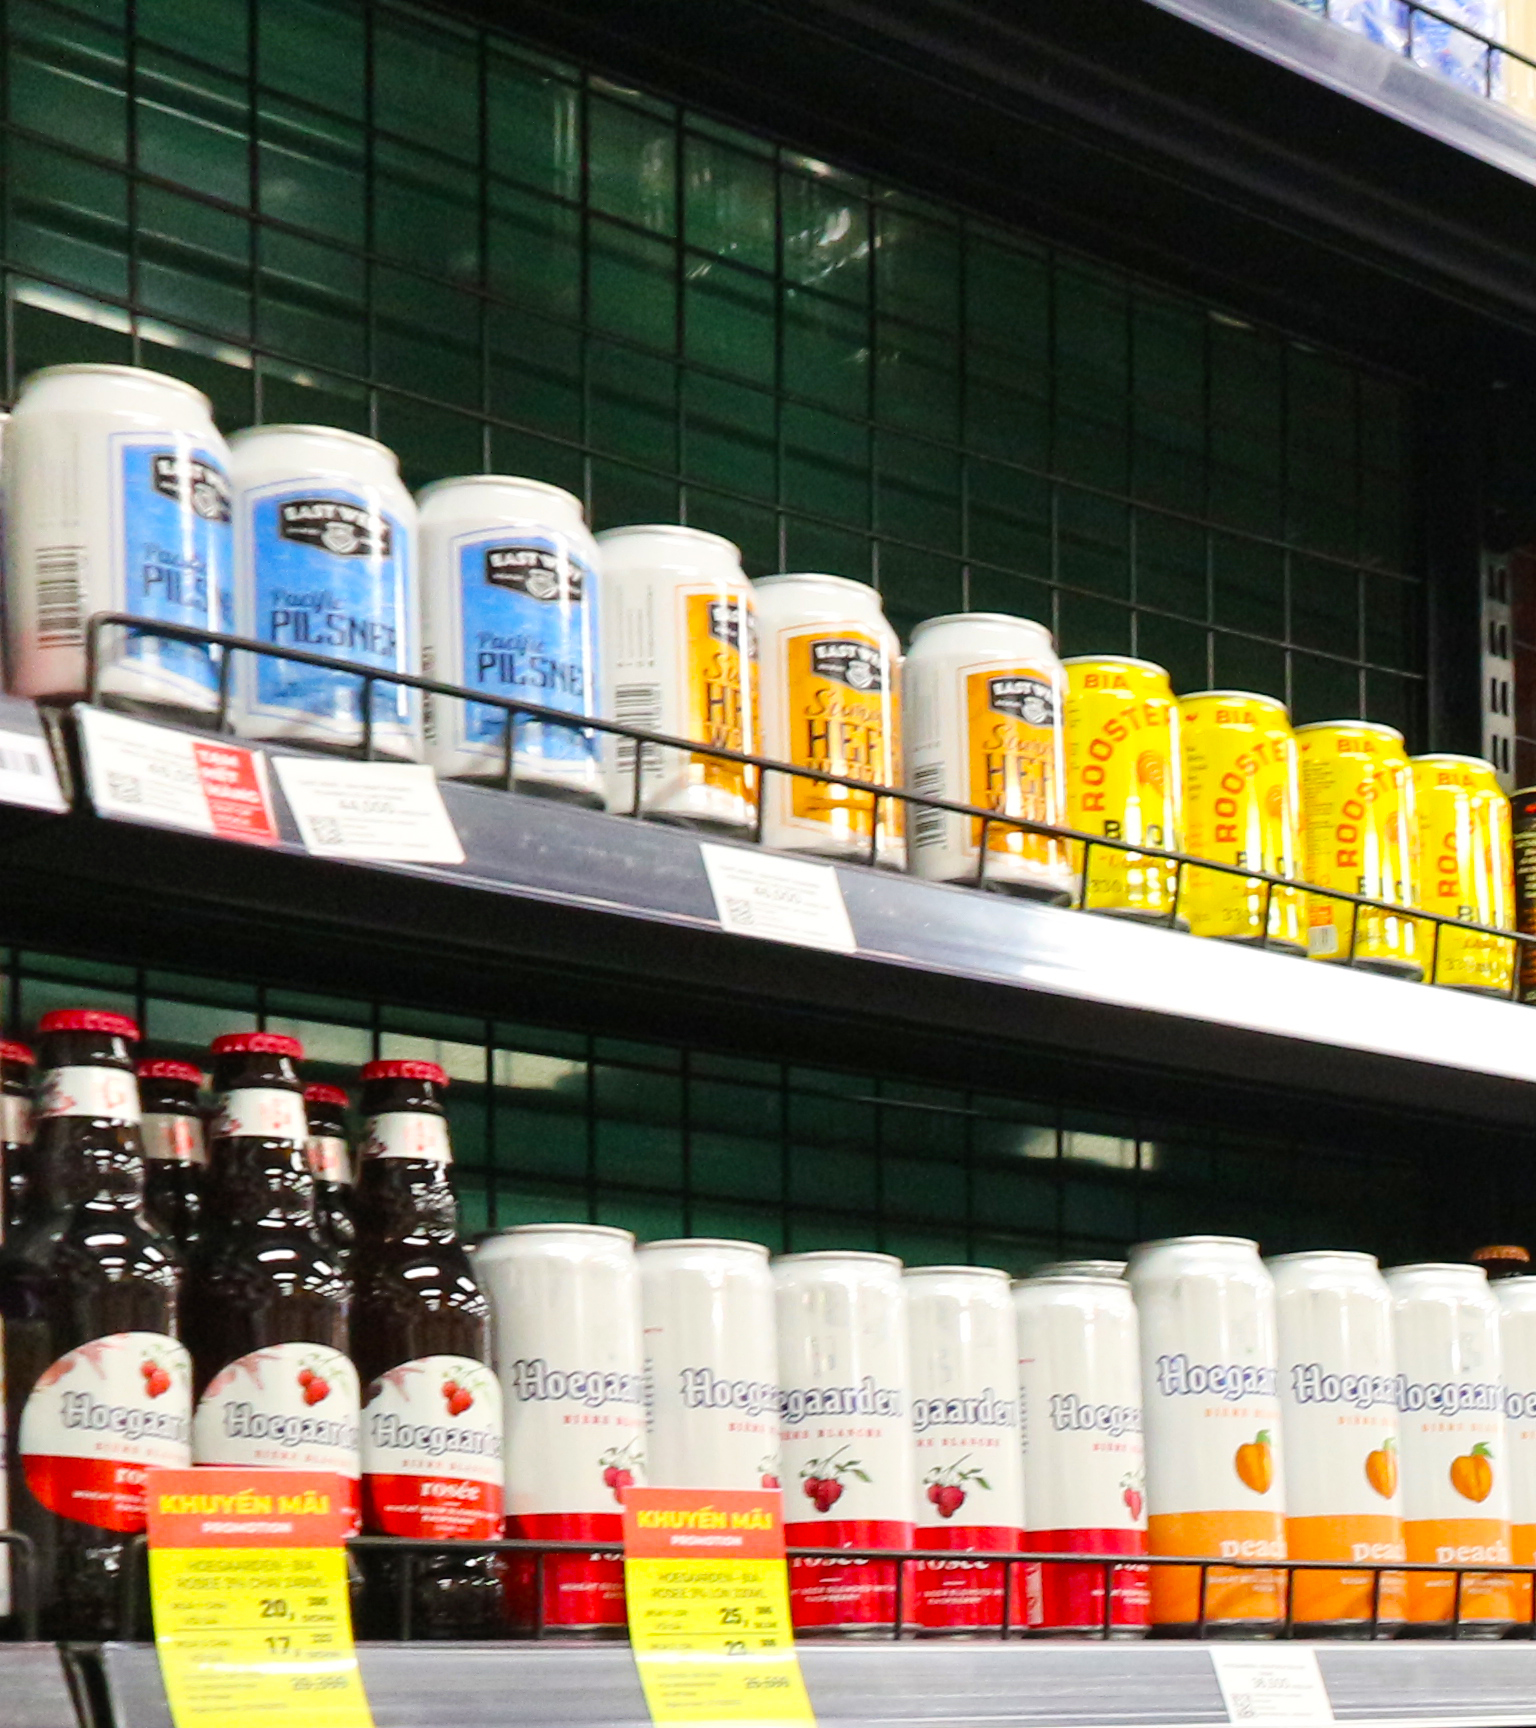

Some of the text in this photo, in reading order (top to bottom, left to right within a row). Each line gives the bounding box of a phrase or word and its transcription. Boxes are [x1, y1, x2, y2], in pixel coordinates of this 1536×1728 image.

[1084, 673, 1129, 691] BIA
[1215, 709, 1258, 726] BIA
[1337, 738, 1378, 755] BIA
[1436, 771, 1475, 788] BIA
[202, 1521, 293, 1535] PROMOTION
